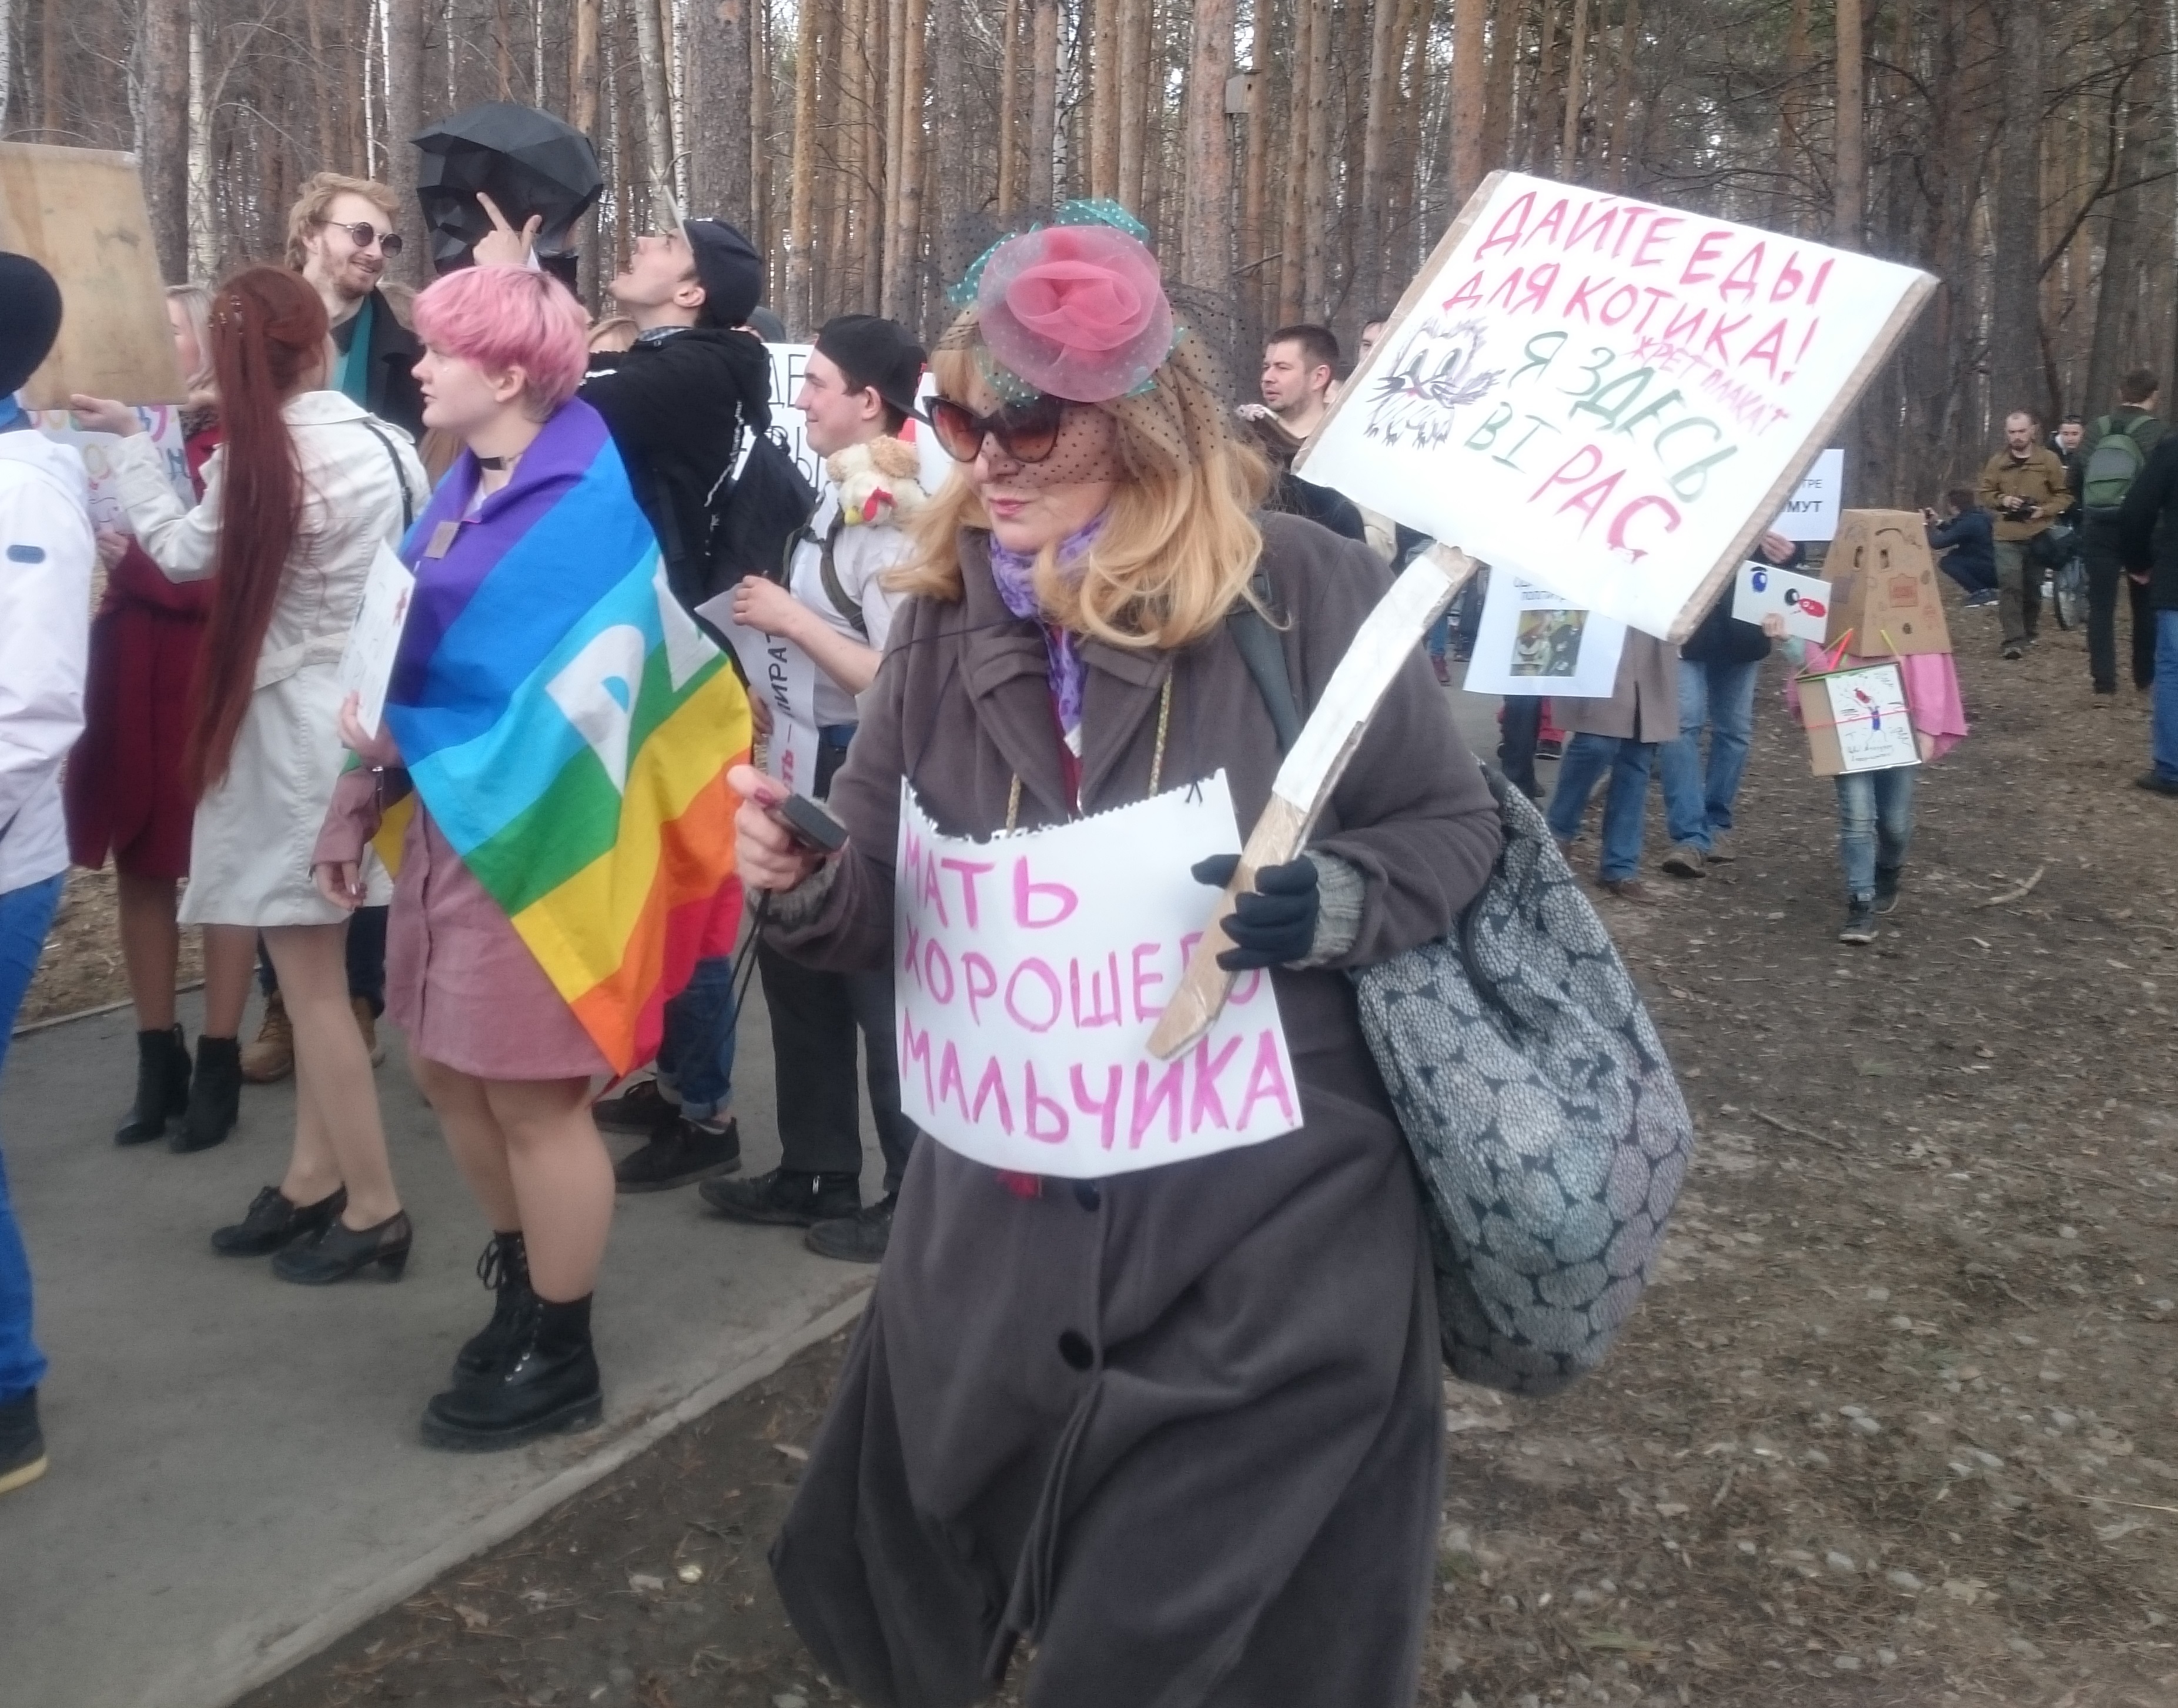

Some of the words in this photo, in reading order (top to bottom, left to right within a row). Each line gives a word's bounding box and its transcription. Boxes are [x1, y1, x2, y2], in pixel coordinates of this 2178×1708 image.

[1473, 191, 1687, 267] ДАЙТЕ
[1678, 230, 1836, 307] ЕДЫ
[1441, 262, 1561, 315] ДЛЯ
[1563, 274, 1820, 386] КОТИКА!
[1508, 330, 1568, 389] Я
[1557, 346, 1739, 503] ЗДЕСЬ
[904, 826, 1078, 929] МАТЬ
[901, 1007, 1294, 1151] МАЛЬЧИКА
